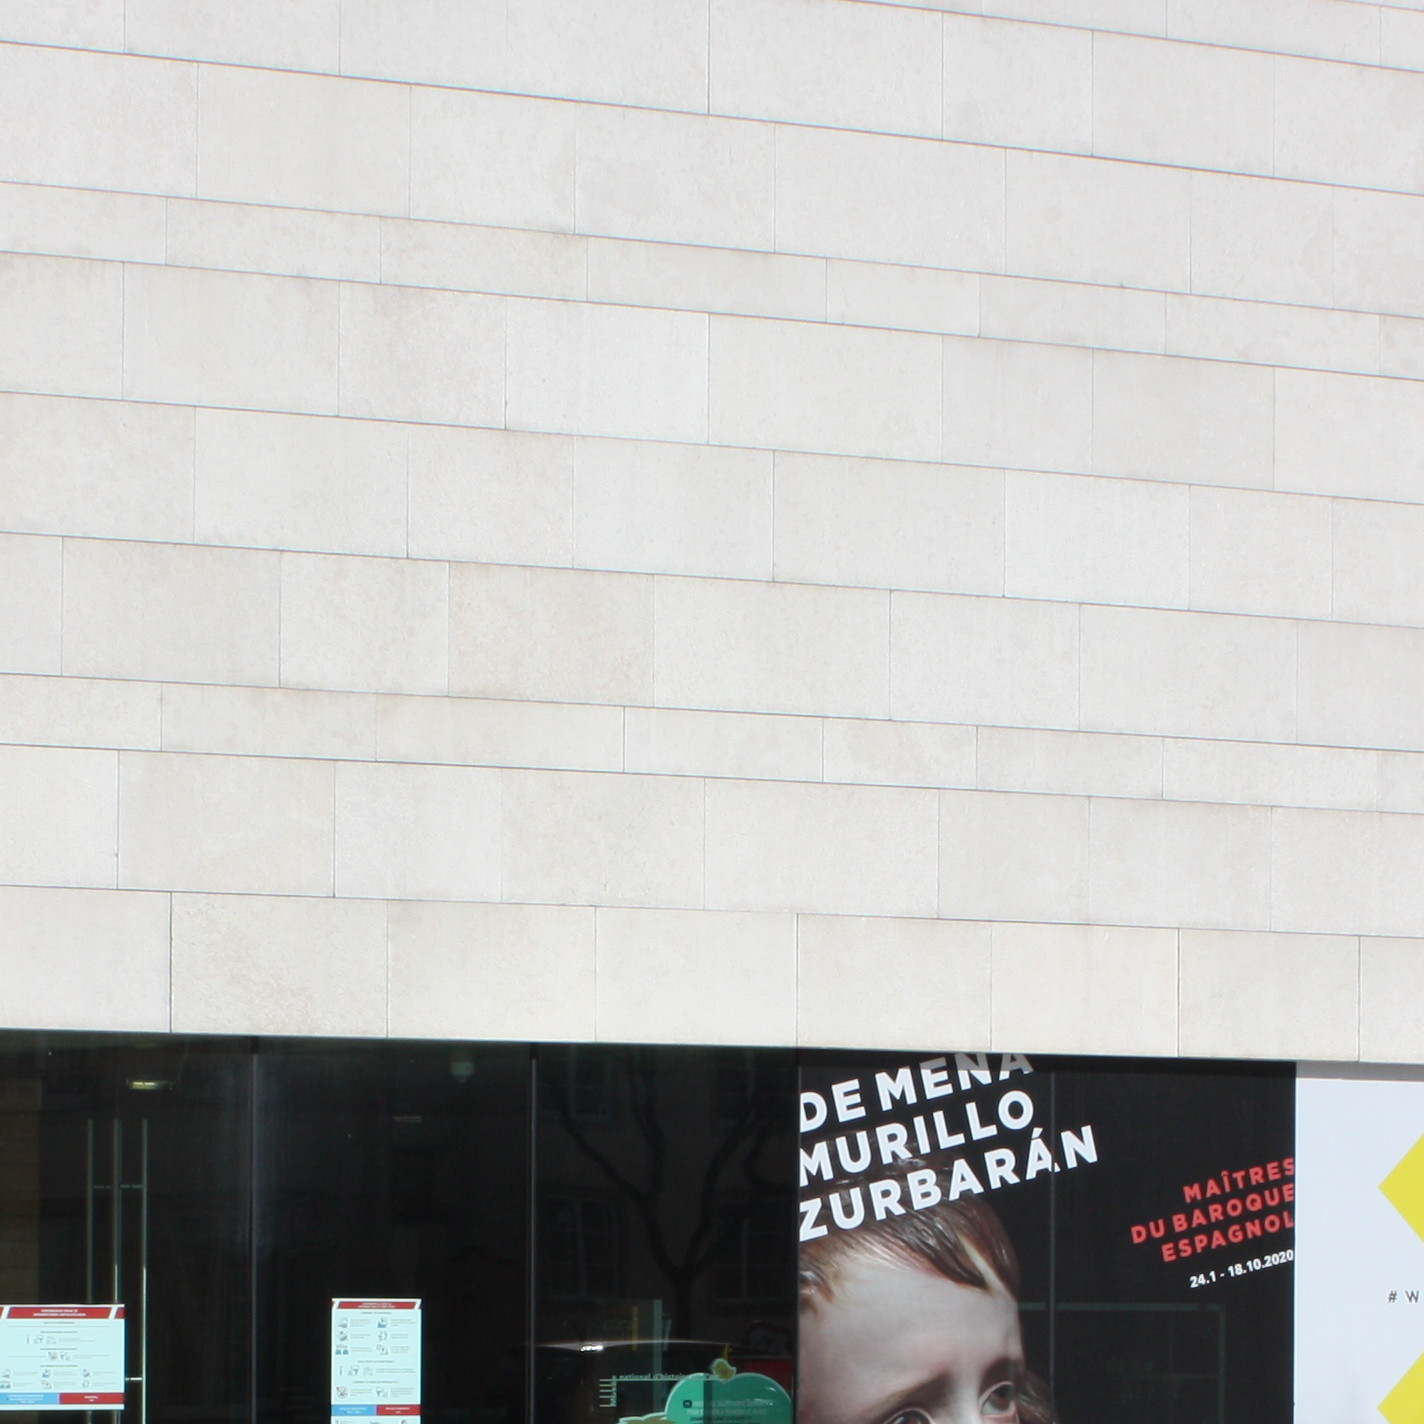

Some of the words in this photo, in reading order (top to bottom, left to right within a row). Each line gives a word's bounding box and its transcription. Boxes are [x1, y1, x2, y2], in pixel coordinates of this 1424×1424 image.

[800, 1079, 866, 1134] DE
[874, 1053, 1034, 1112] MENA
[799, 1090, 1035, 1188] MURILLO
[798, 1124, 1099, 1243] ZURBARÁN
[1182, 1157, 1295, 1205] MAÎTRES
[1130, 1218, 1166, 1245] DU
[1173, 1182, 1295, 1233] BAROQUE
[1161, 1211, 1294, 1263] ESPAGNOL
[1189, 1269, 1217, 1288] 24.1
[1227, 1249, 1294, 1278] 18.10.2020
